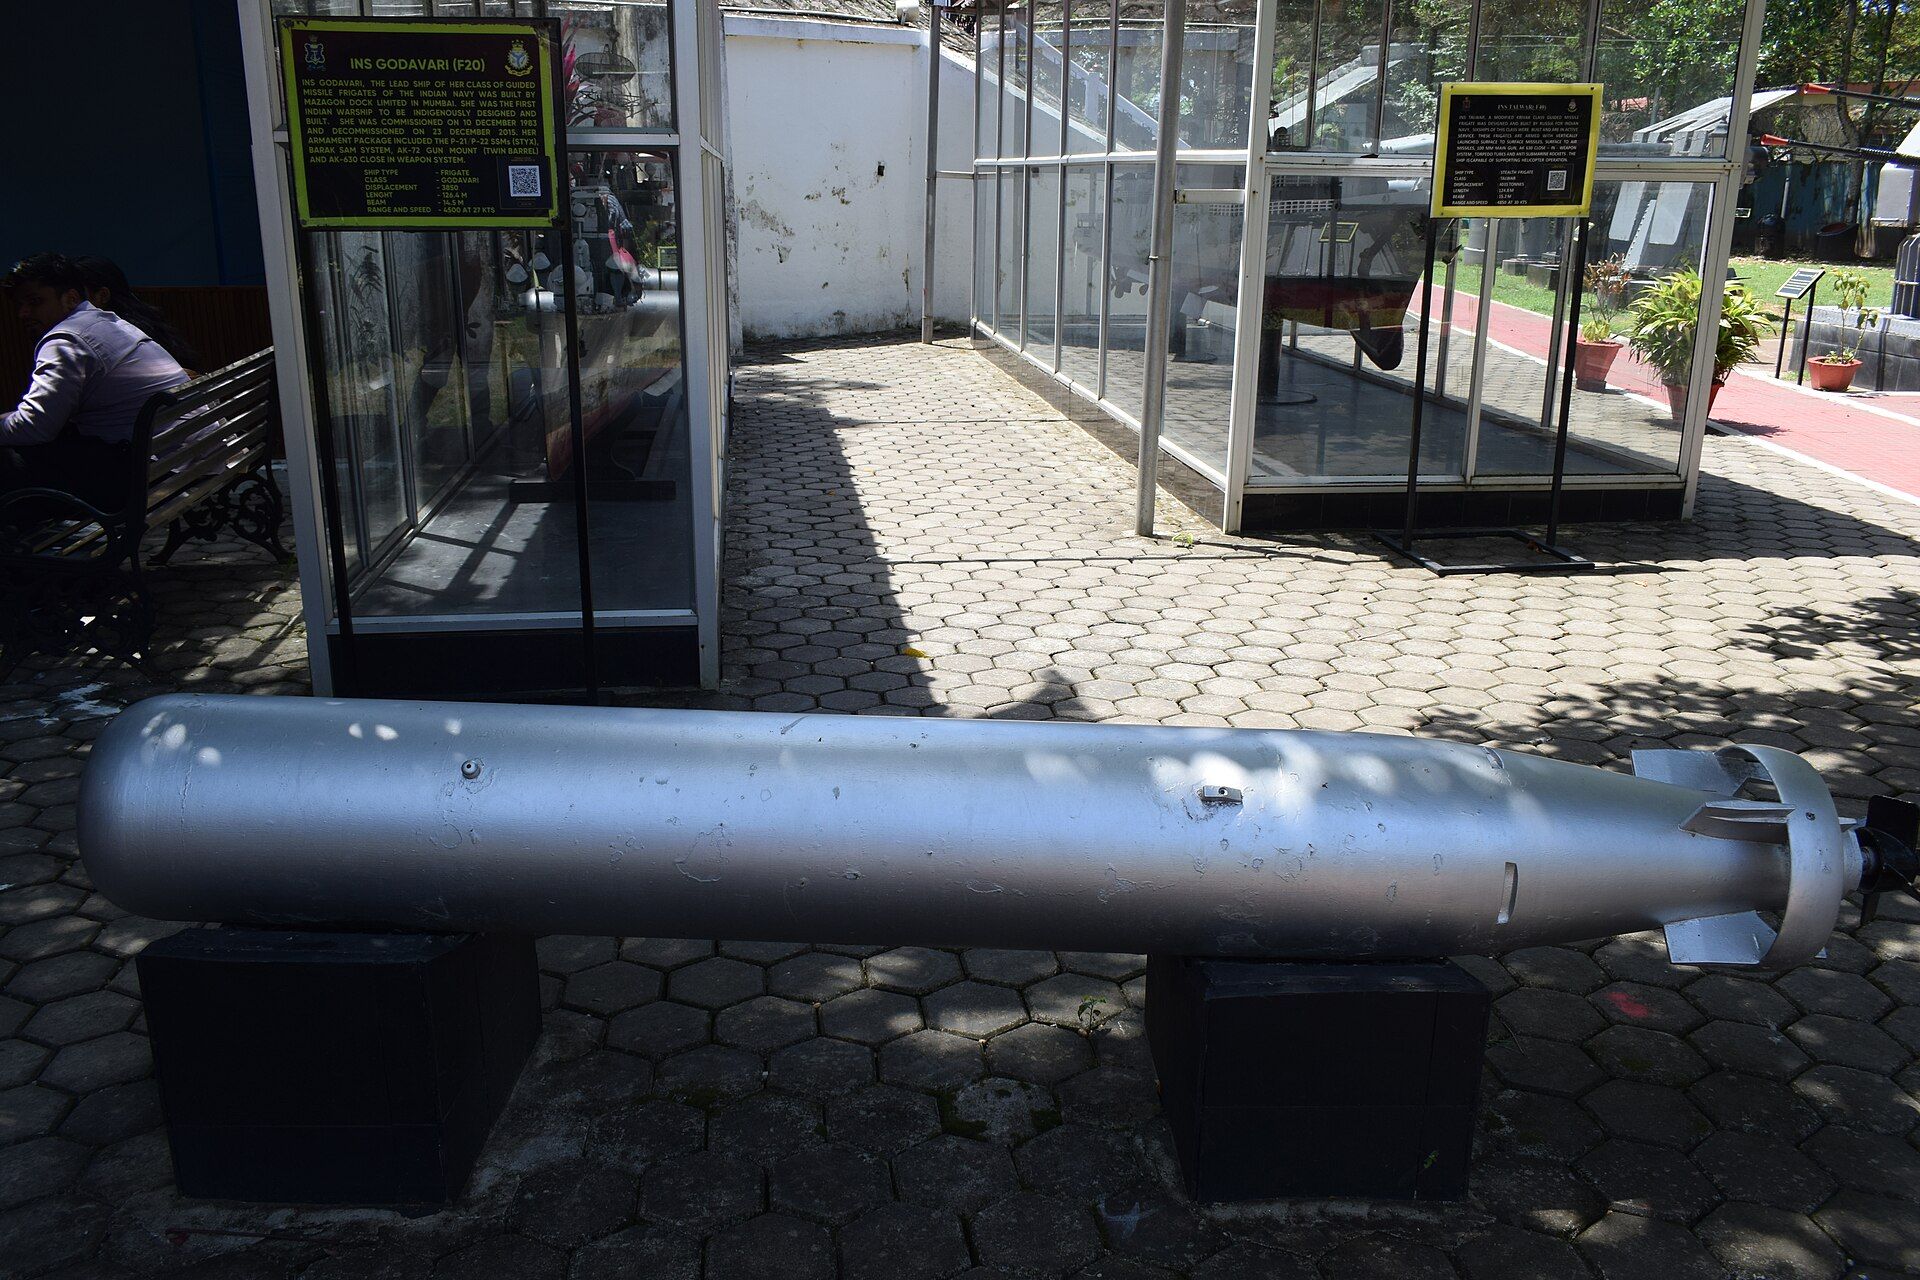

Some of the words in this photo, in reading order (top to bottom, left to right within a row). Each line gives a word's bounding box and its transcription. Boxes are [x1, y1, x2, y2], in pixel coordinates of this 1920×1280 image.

[350, 58, 372, 70] INS
[375, 58, 449, 70] GODAVARI
[452, 59, 485, 72] (F20)
[483, 147, 507, 155] (TWIN
[507, 147, 539, 156] BARREL)
